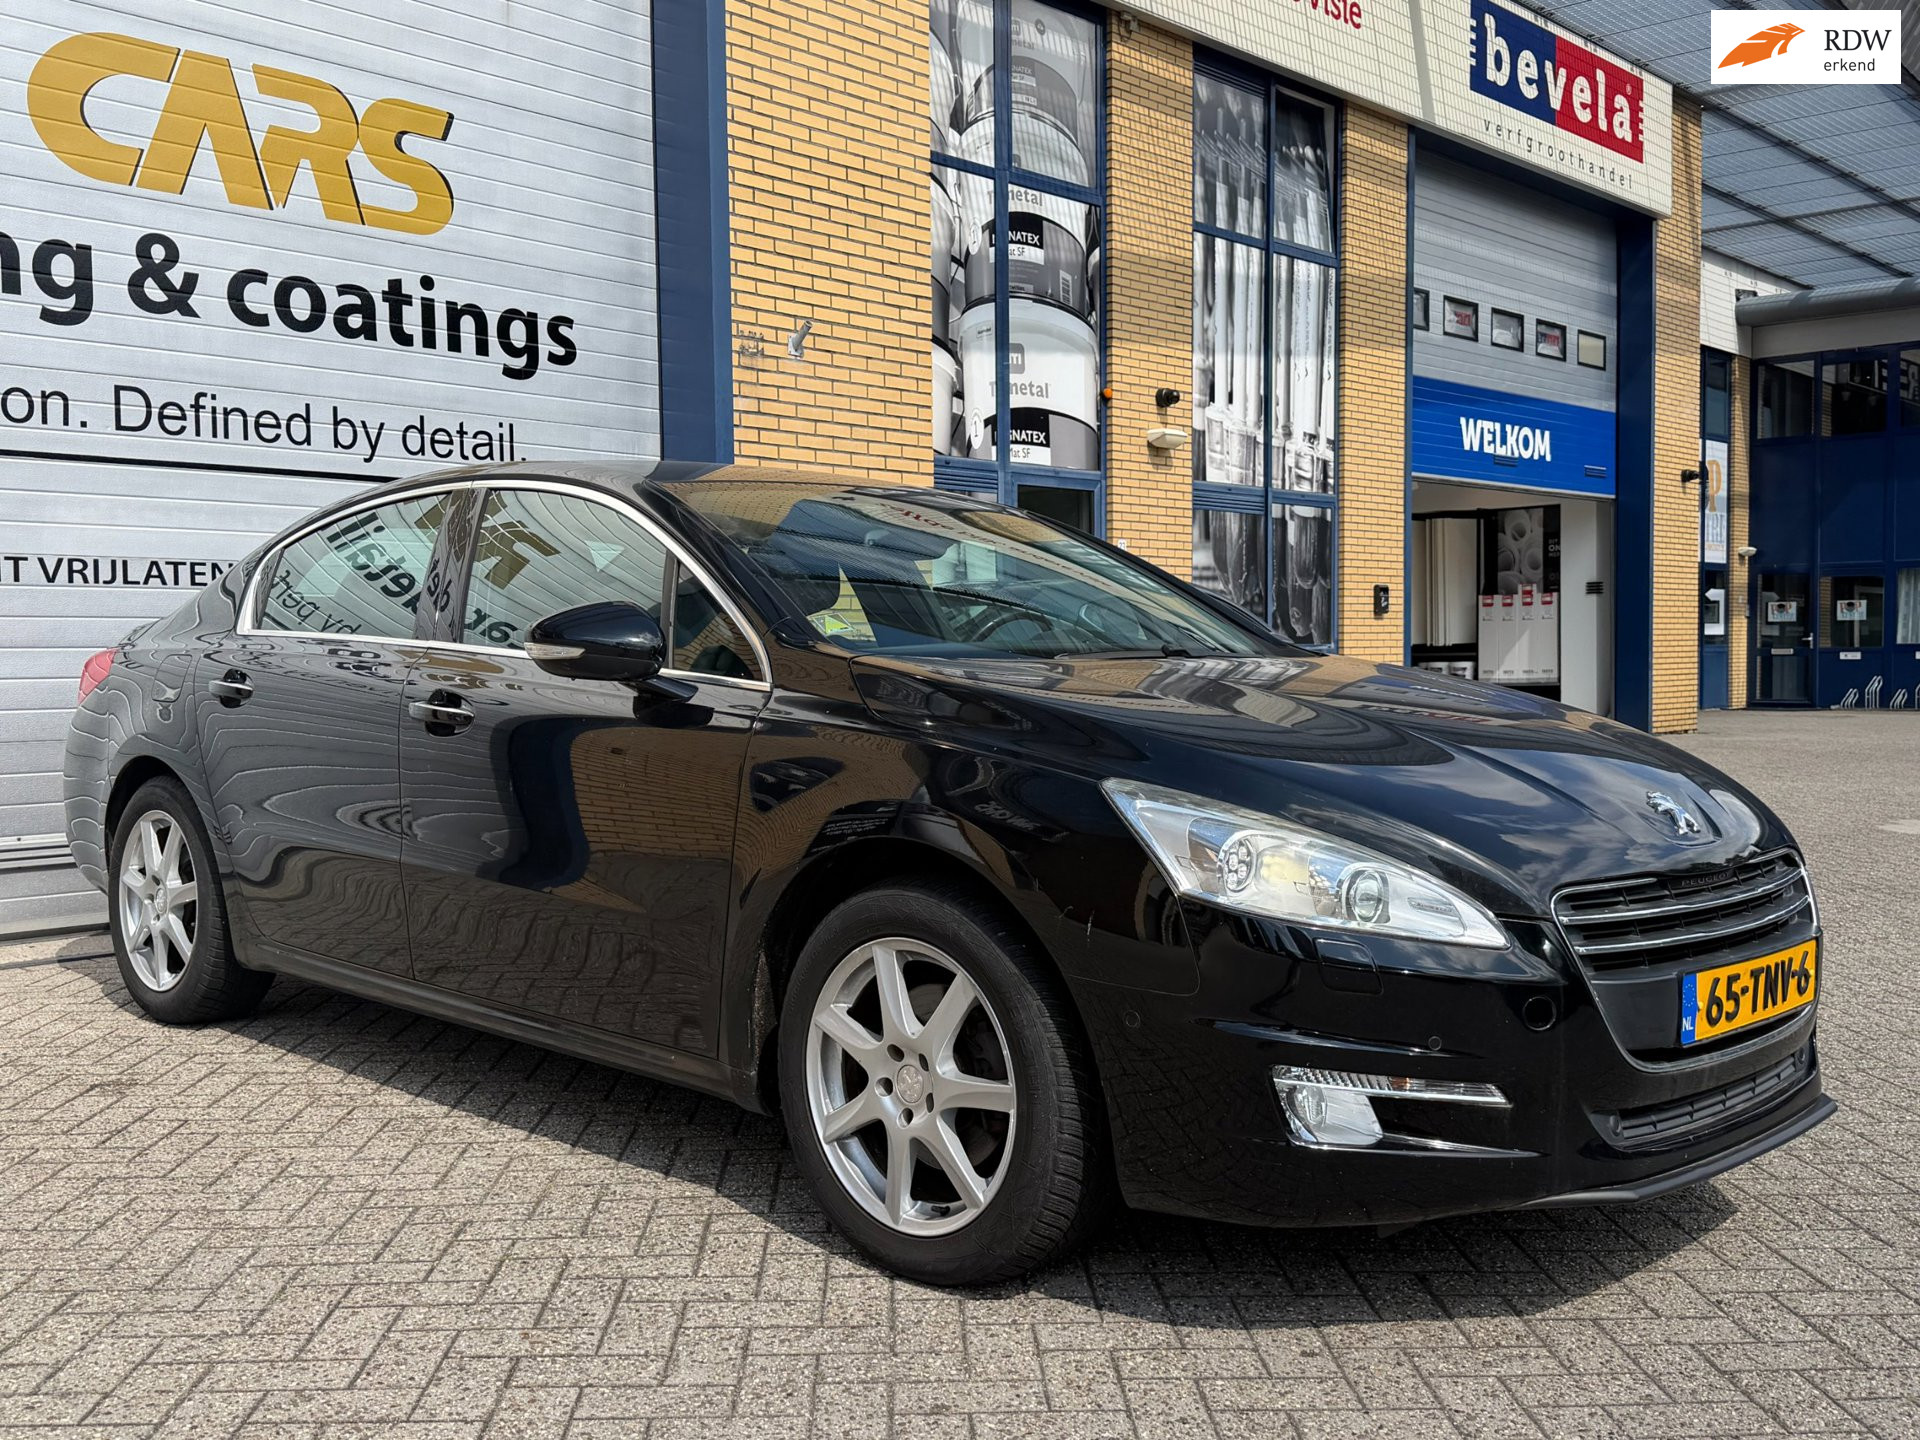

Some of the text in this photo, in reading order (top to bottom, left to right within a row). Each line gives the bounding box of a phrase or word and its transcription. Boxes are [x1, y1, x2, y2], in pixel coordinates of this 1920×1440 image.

[1484, 12, 1633, 143] bevela
[27, 32, 455, 236] CARS
[1483, 119, 1632, 189] verfgroothandel
[128, 232, 201, 319] &
[227, 268, 577, 380] coatings
[0, 384, 527, 463] on. Defined by detail.
[1460, 416, 1552, 462] WELKOM
[0, 556, 28, 583] T
[1682, 1016, 1694, 1031] NL
[1706, 950, 1811, 1028] 65-TNV-6
